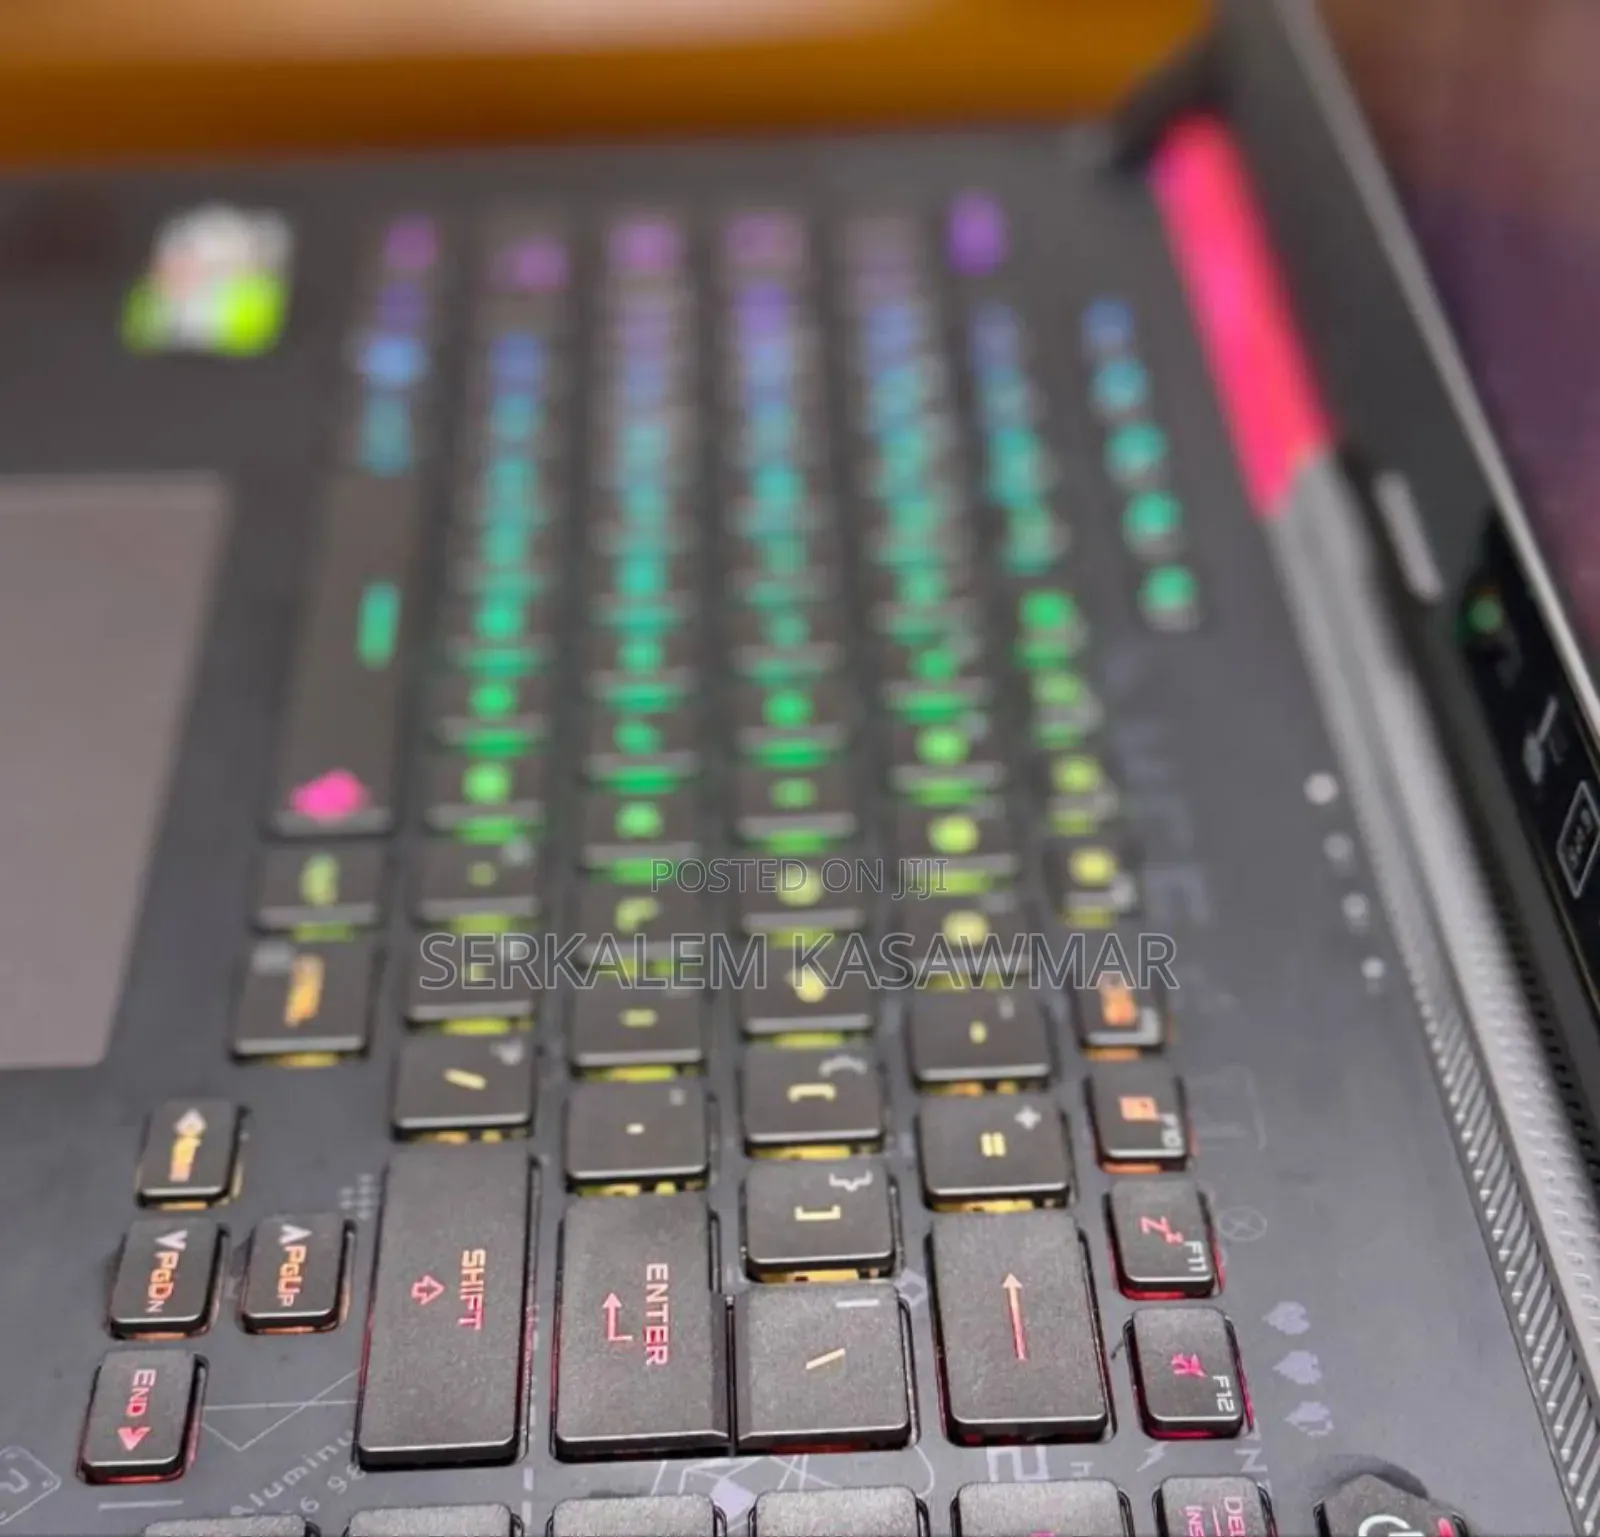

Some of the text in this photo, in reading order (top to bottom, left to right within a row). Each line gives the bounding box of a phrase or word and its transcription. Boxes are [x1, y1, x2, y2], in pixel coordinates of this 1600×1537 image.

[458, 1248, 487, 1330] SHIFT
[1184, 1240, 1208, 1272] F11
[645, 1262, 669, 1366] ENTER
[126, 1368, 157, 1418] END
[1212, 1375, 1235, 1412] F12
[230, 1429, 355, 1516] Aluminu
